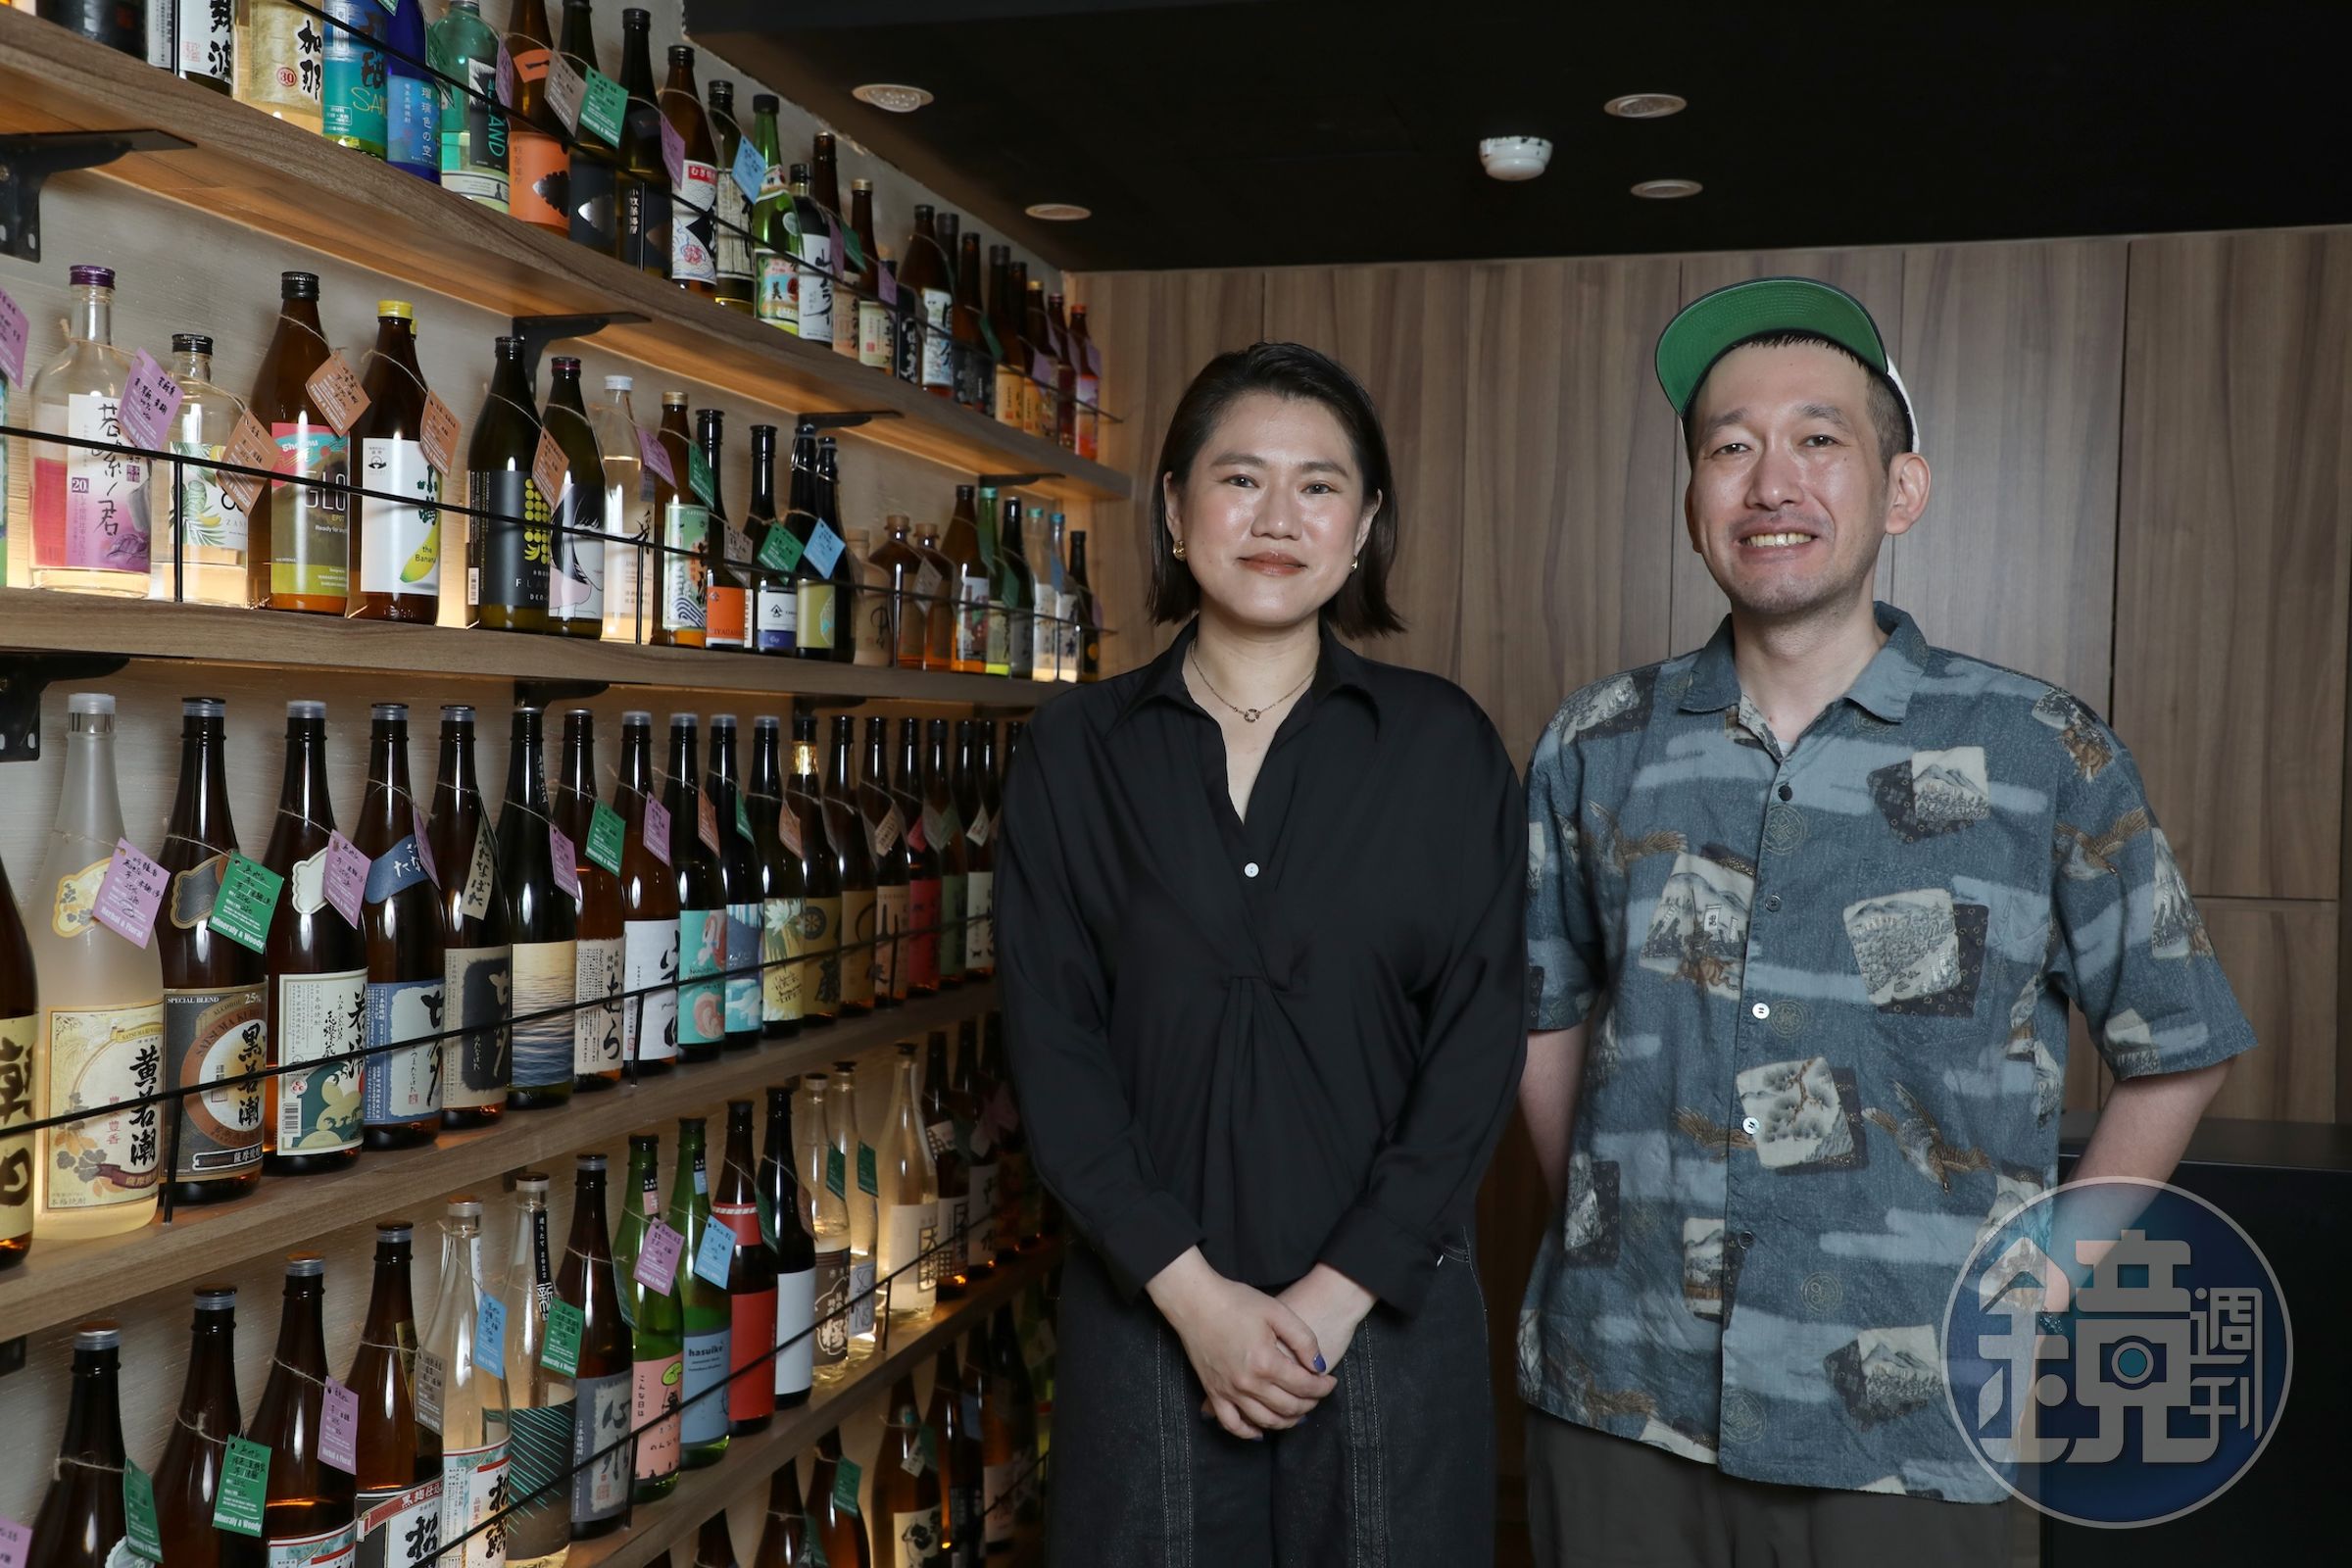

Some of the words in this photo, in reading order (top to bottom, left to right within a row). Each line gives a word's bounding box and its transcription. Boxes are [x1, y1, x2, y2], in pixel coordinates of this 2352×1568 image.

[280, 72, 294, 84] 30
[73, 479, 87, 490] 20
[422, 545, 432, 555] the
[100, 906, 121, 925] Herbal
[126, 921, 144, 940] Floral
[212, 914, 238, 936] Mineraly
[244, 930, 265, 951] Woody
[244, 992, 263, 1005] 25%
[50, 1197, 86, 1206] 本格焼酎
[214, 1511, 239, 1530] Mineraly
[244, 1517, 263, 1534] Woody
